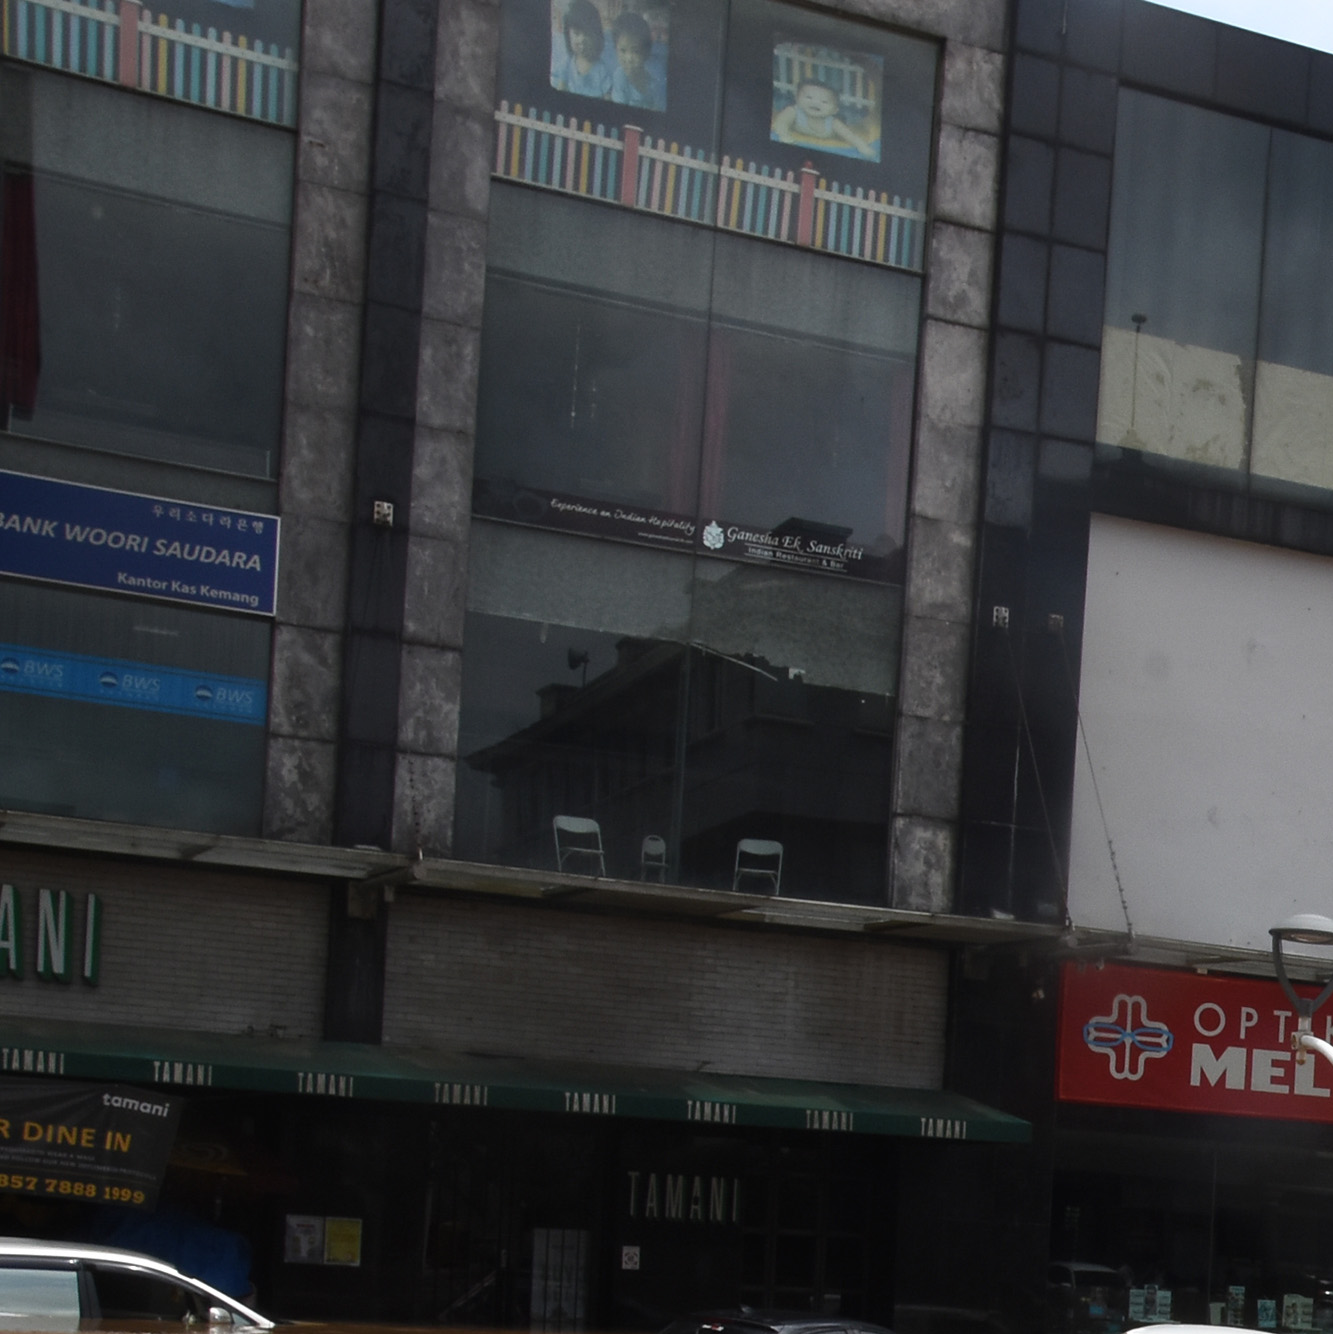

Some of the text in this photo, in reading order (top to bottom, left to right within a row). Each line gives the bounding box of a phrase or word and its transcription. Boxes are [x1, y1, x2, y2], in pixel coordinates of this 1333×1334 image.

[550, 498, 597, 516] Experience
[64, 523, 148, 552] WOORI
[153, 538, 261, 571] SAUDARA
[727, 526, 779, 546] Ganesha
[806, 539, 864, 561] Sanskriti
[117, 572, 259, 608] Kantor Kas Kemang
[23, 659, 65, 677] BWS
[122, 674, 161, 691] BWS
[215, 687, 253, 704] BWS
[2, 1047, 65, 1075] TAMANI
[153, 1060, 213, 1086] TAMANI
[297, 1072, 354, 1098] TAMANI
[434, 1081, 488, 1106] TAMANI
[102, 1093, 170, 1117] tamani
[564, 1092, 616, 1115] TAMANI
[687, 1100, 736, 1124] TAMANI
[806, 1109, 854, 1132] TAMANI
[920, 1117, 967, 1139] TAMANI
[22, 1121, 96, 1148] DINE
[104, 1130, 132, 1152] IN
[45, 1179, 97, 1198] 7888
[103, 1186, 145, 1204] 1999
[627, 1170, 738, 1222] TAMANI
